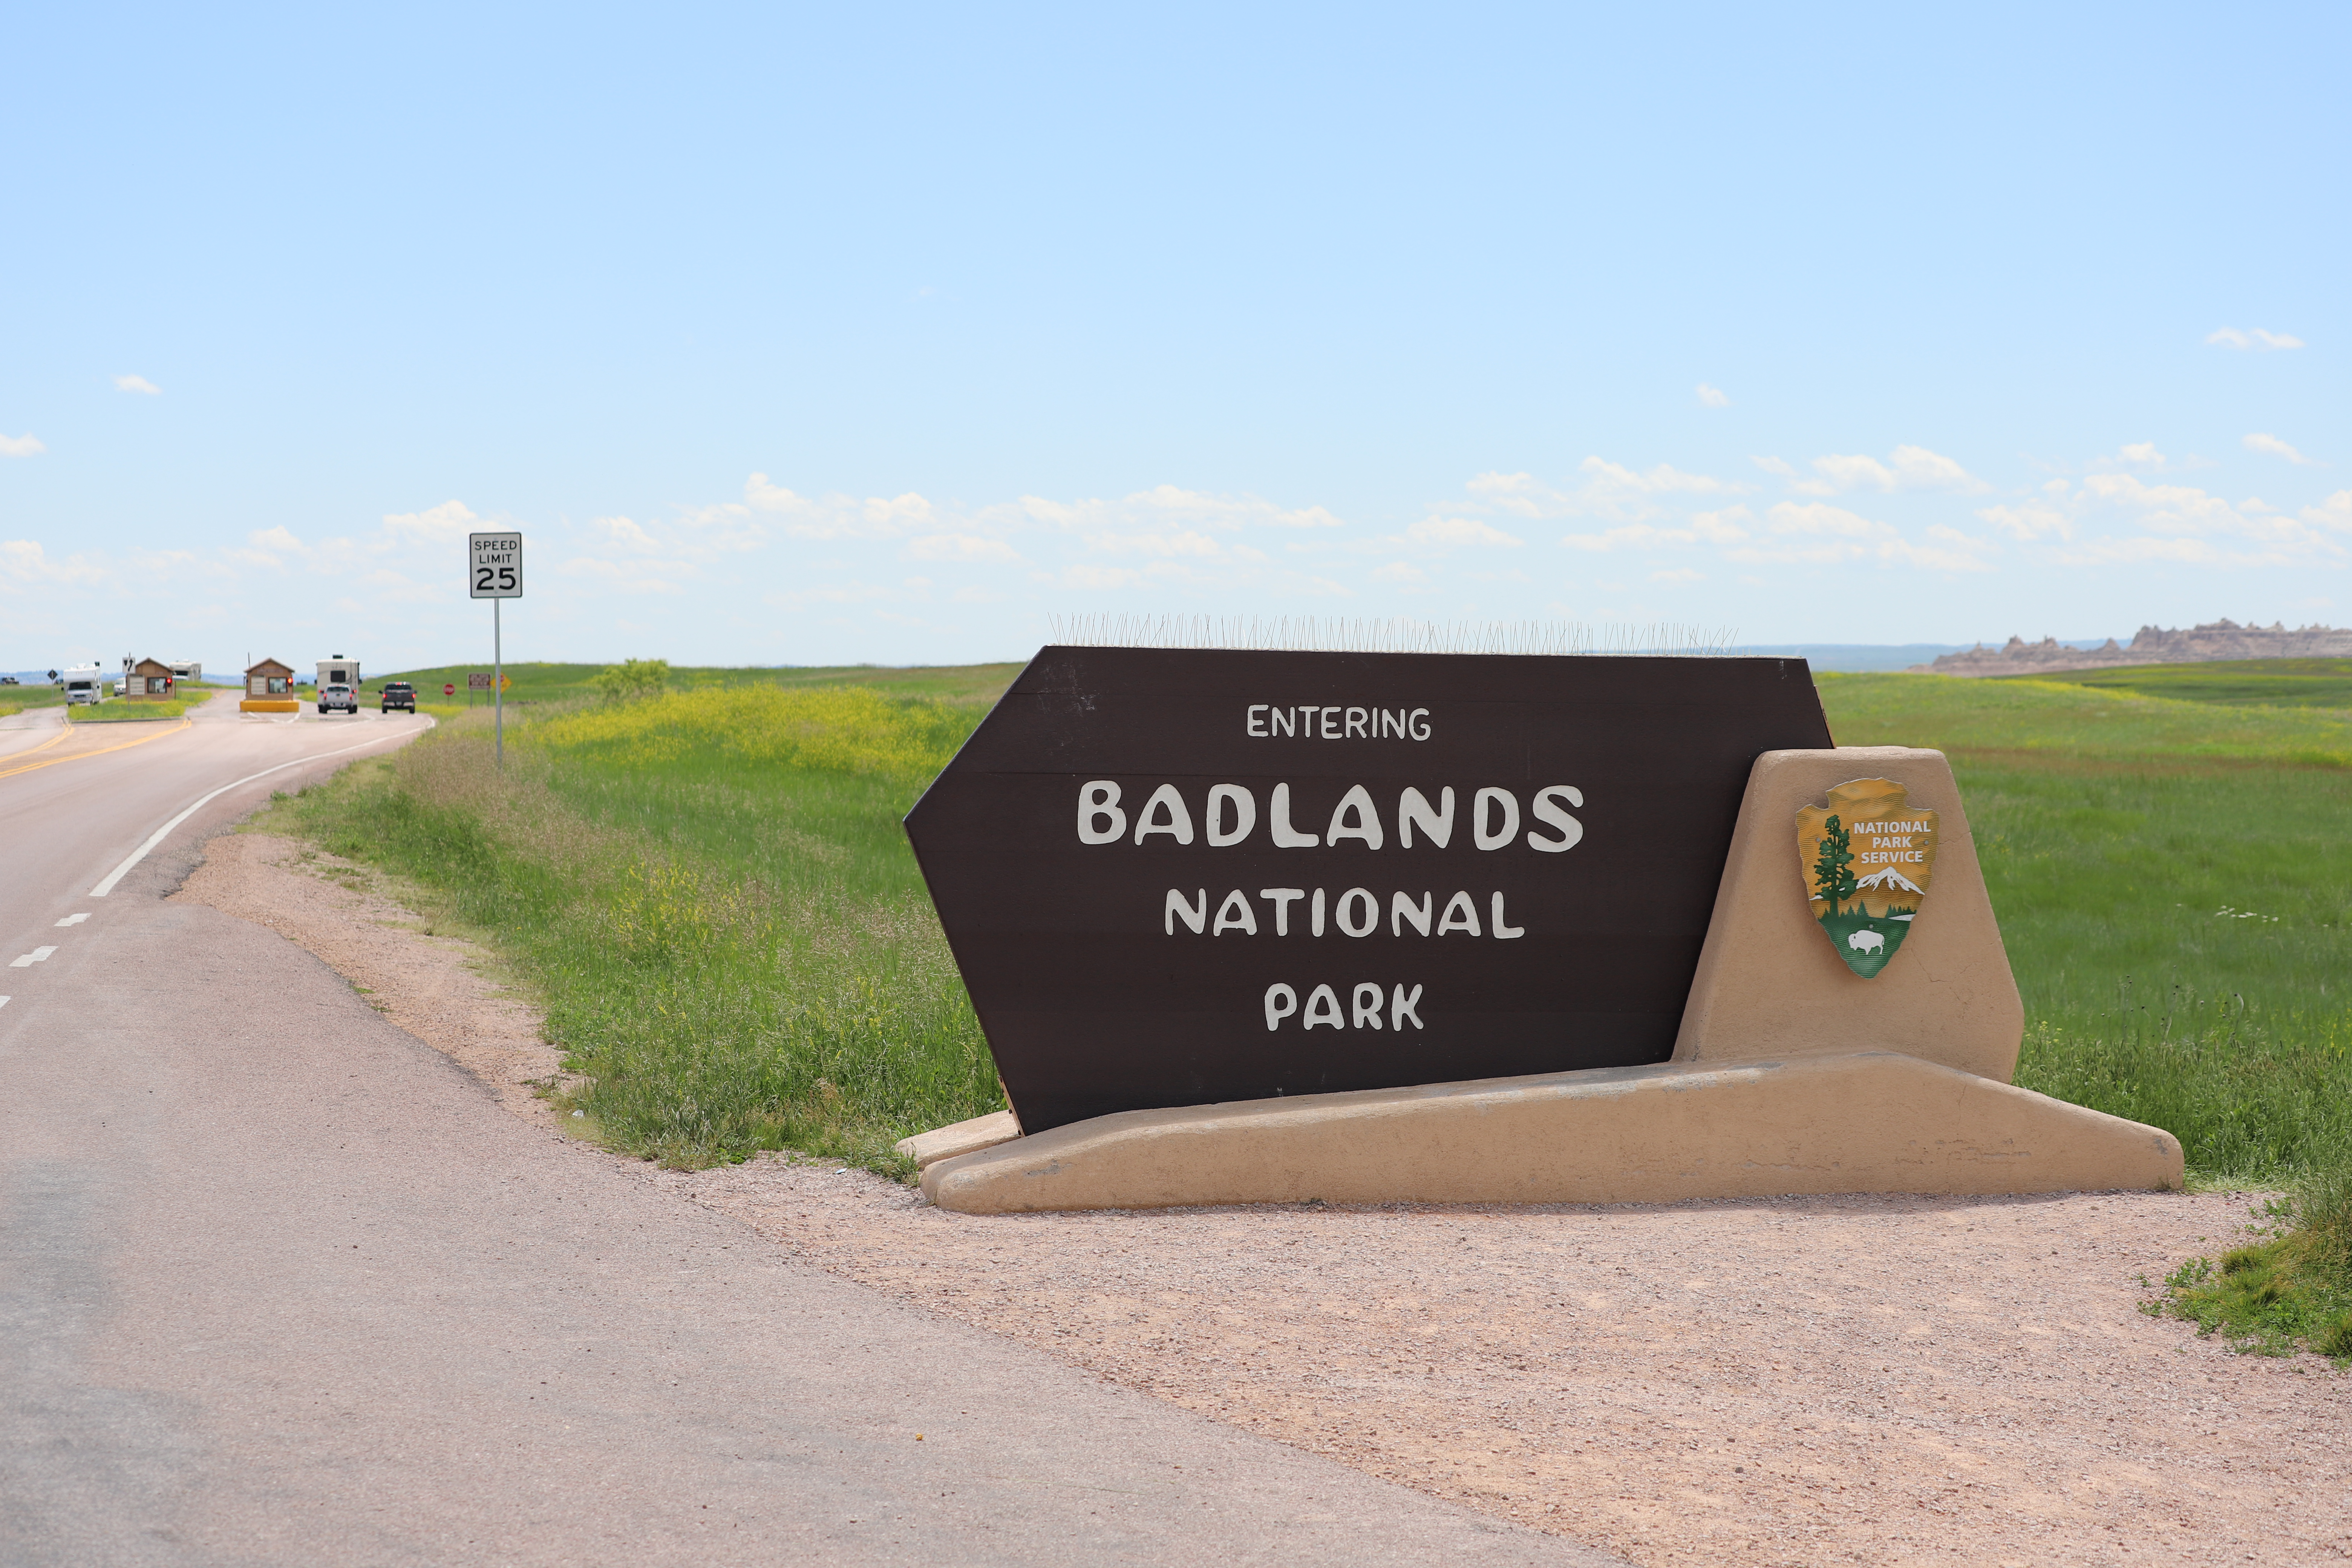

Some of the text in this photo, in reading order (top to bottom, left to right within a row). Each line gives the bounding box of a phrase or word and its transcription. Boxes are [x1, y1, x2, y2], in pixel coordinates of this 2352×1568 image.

[475, 541, 517, 550] SPEED
[479, 554, 512, 564] LIMIT
[476, 568, 516, 590] 25
[1247, 704, 1431, 741] ENTERING
[1077, 780, 1583, 853] BADLANDS
[1854, 821, 1931, 833] NATIONAL
[1873, 836, 1912, 848] PARK
[1861, 851, 1923, 864] SERVICE
[1165, 887, 1525, 939] NATIONAL
[1264, 982, 1424, 1031] PARK
